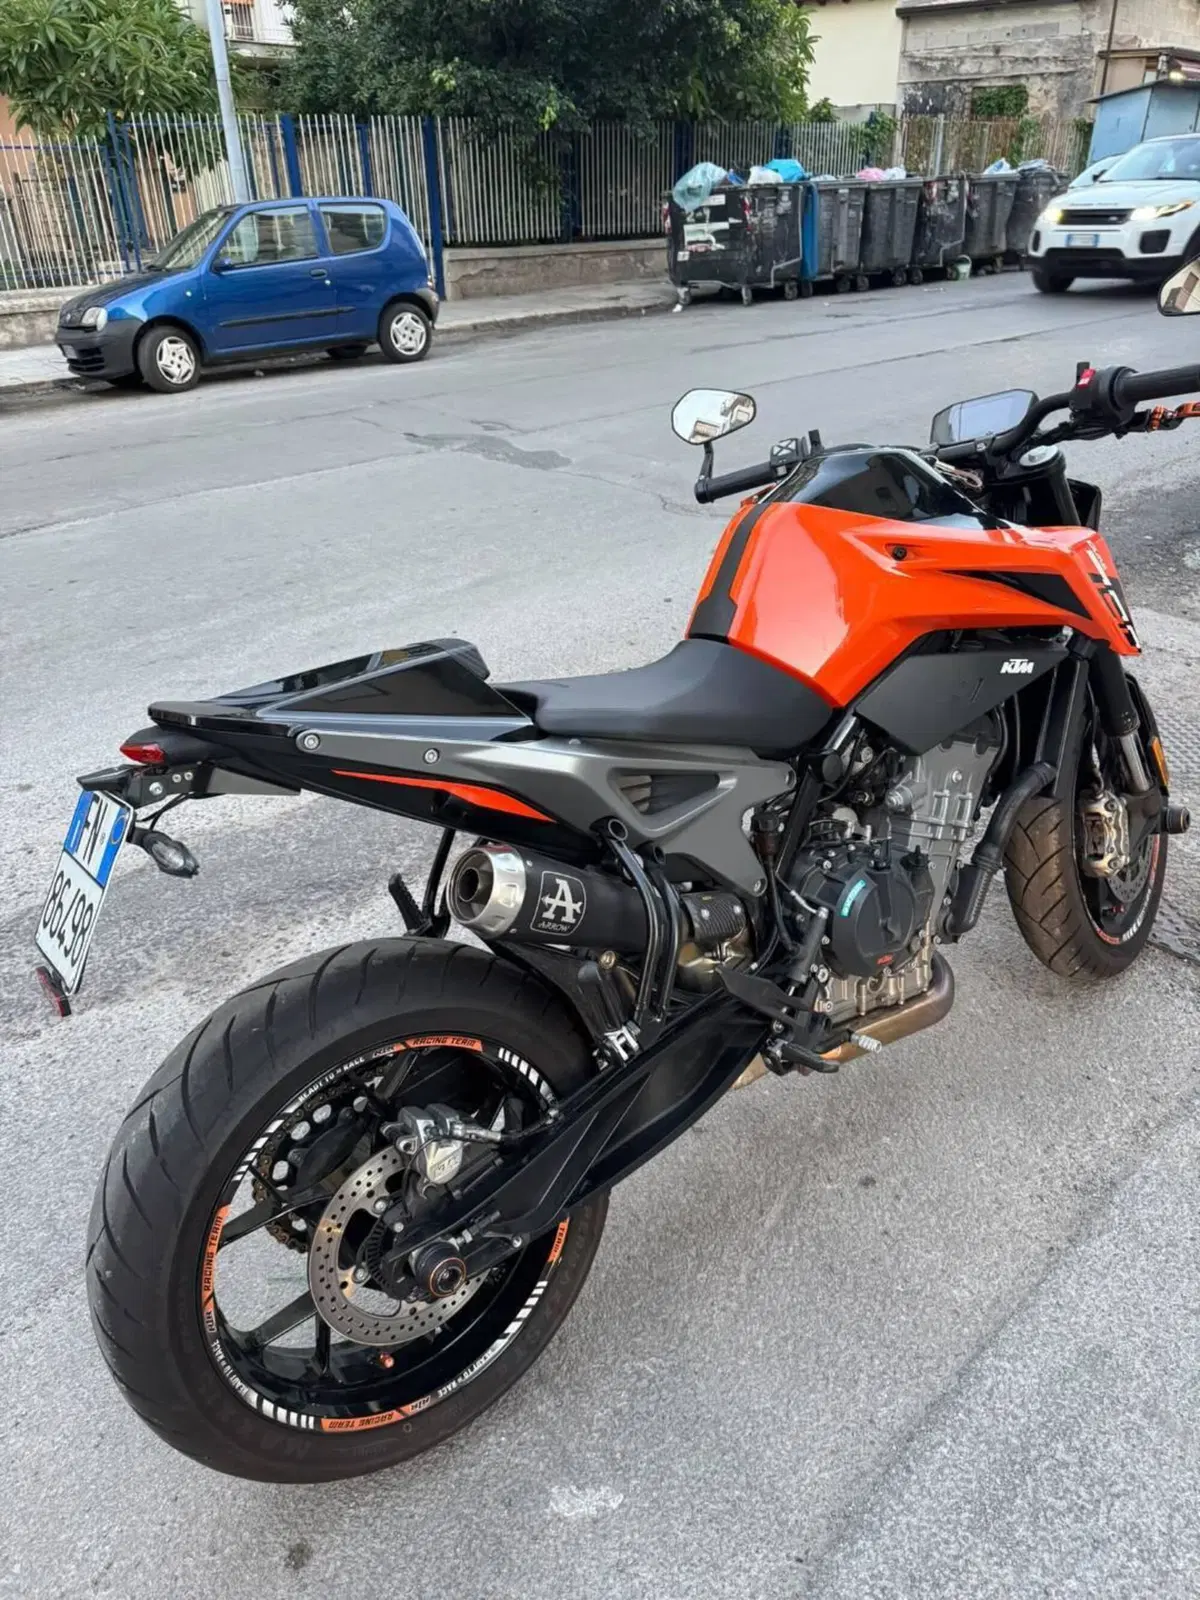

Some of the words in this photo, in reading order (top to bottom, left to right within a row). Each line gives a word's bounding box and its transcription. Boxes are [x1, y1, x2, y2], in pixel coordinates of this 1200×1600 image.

[1000, 658, 1035, 674] KTM
[43, 870, 94, 965] 86498
[537, 921, 571, 932] ARROW
[297, 1081, 324, 1103] READY
[343, 1056, 366, 1072] RACE
[412, 1037, 448, 1047] RACING
[449, 1038, 478, 1047] TEAM
[204, 1252, 215, 1292] RACING
[437, 1381, 459, 1399] RACE
[328, 1419, 356, 1429] TEAM
[358, 1413, 395, 1427] RACING
